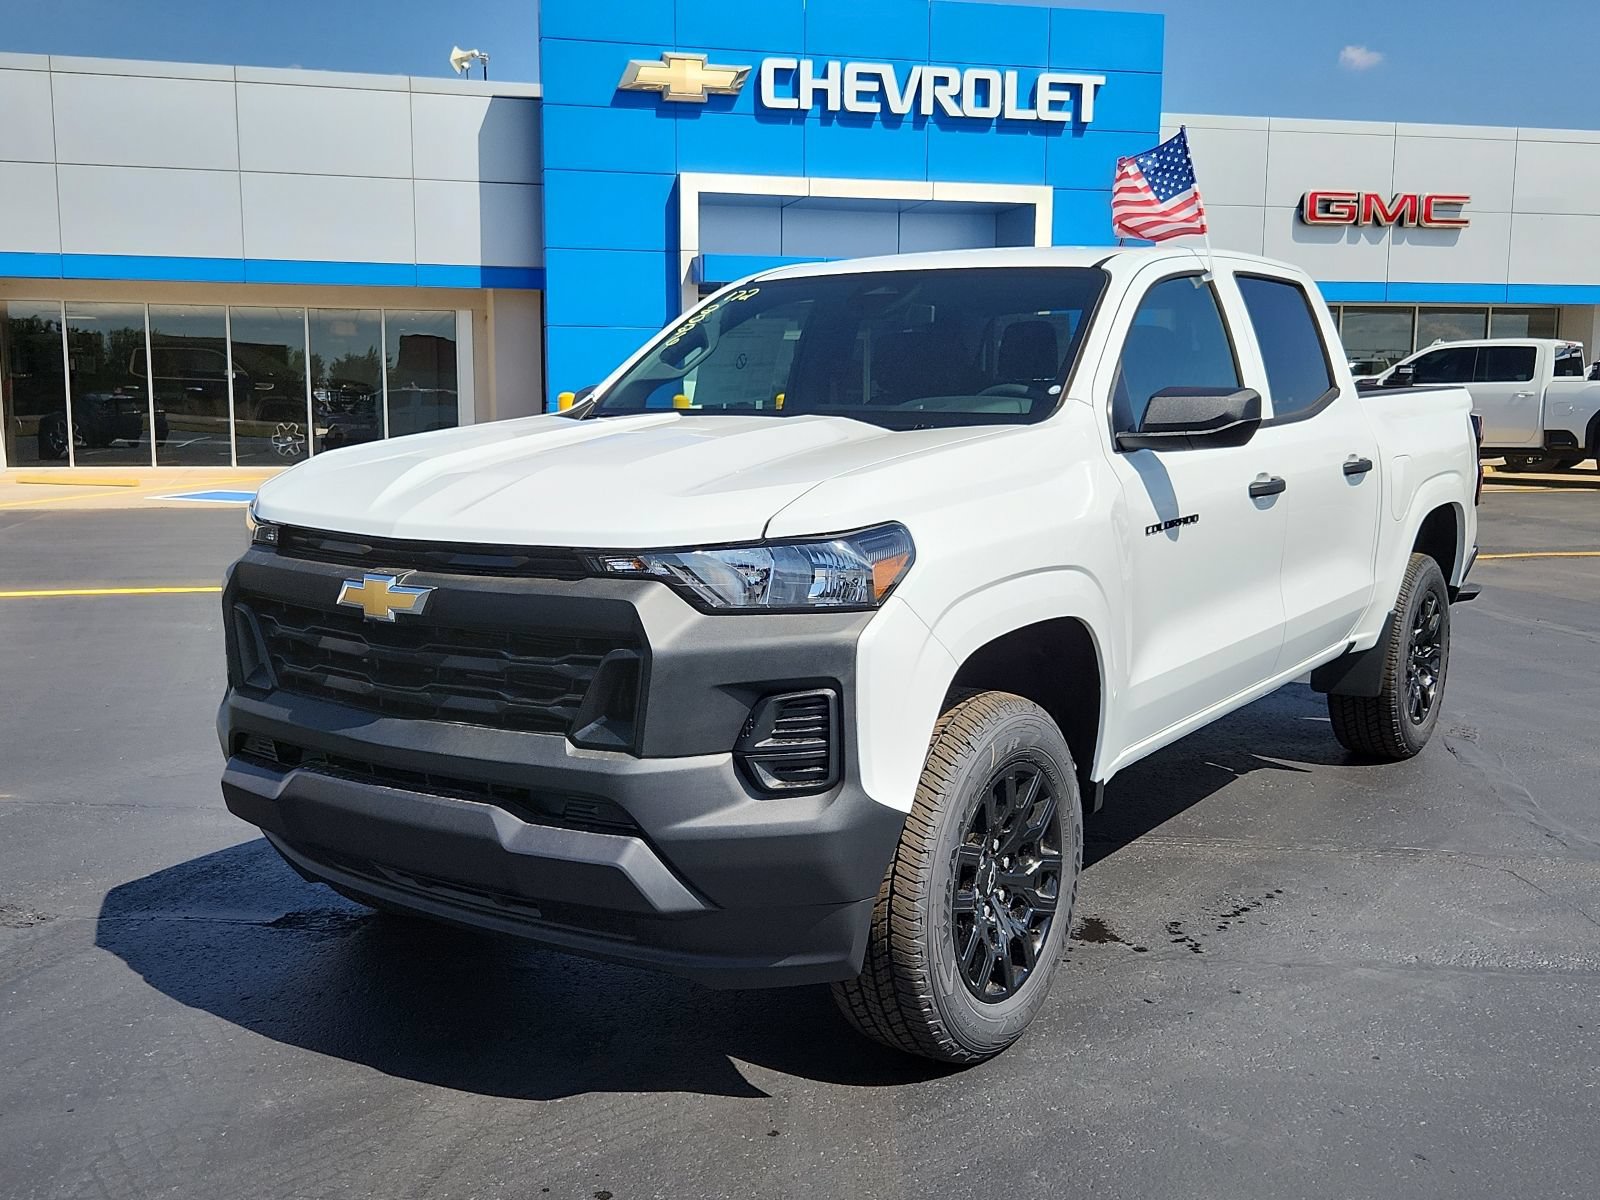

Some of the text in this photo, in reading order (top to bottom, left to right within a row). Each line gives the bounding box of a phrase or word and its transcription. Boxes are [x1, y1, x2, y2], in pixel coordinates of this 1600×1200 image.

[761, 58, 1106, 122] CHEVROLET
[1304, 189, 1471, 229] GMC
[1146, 514, 1199, 535] COLORADO
